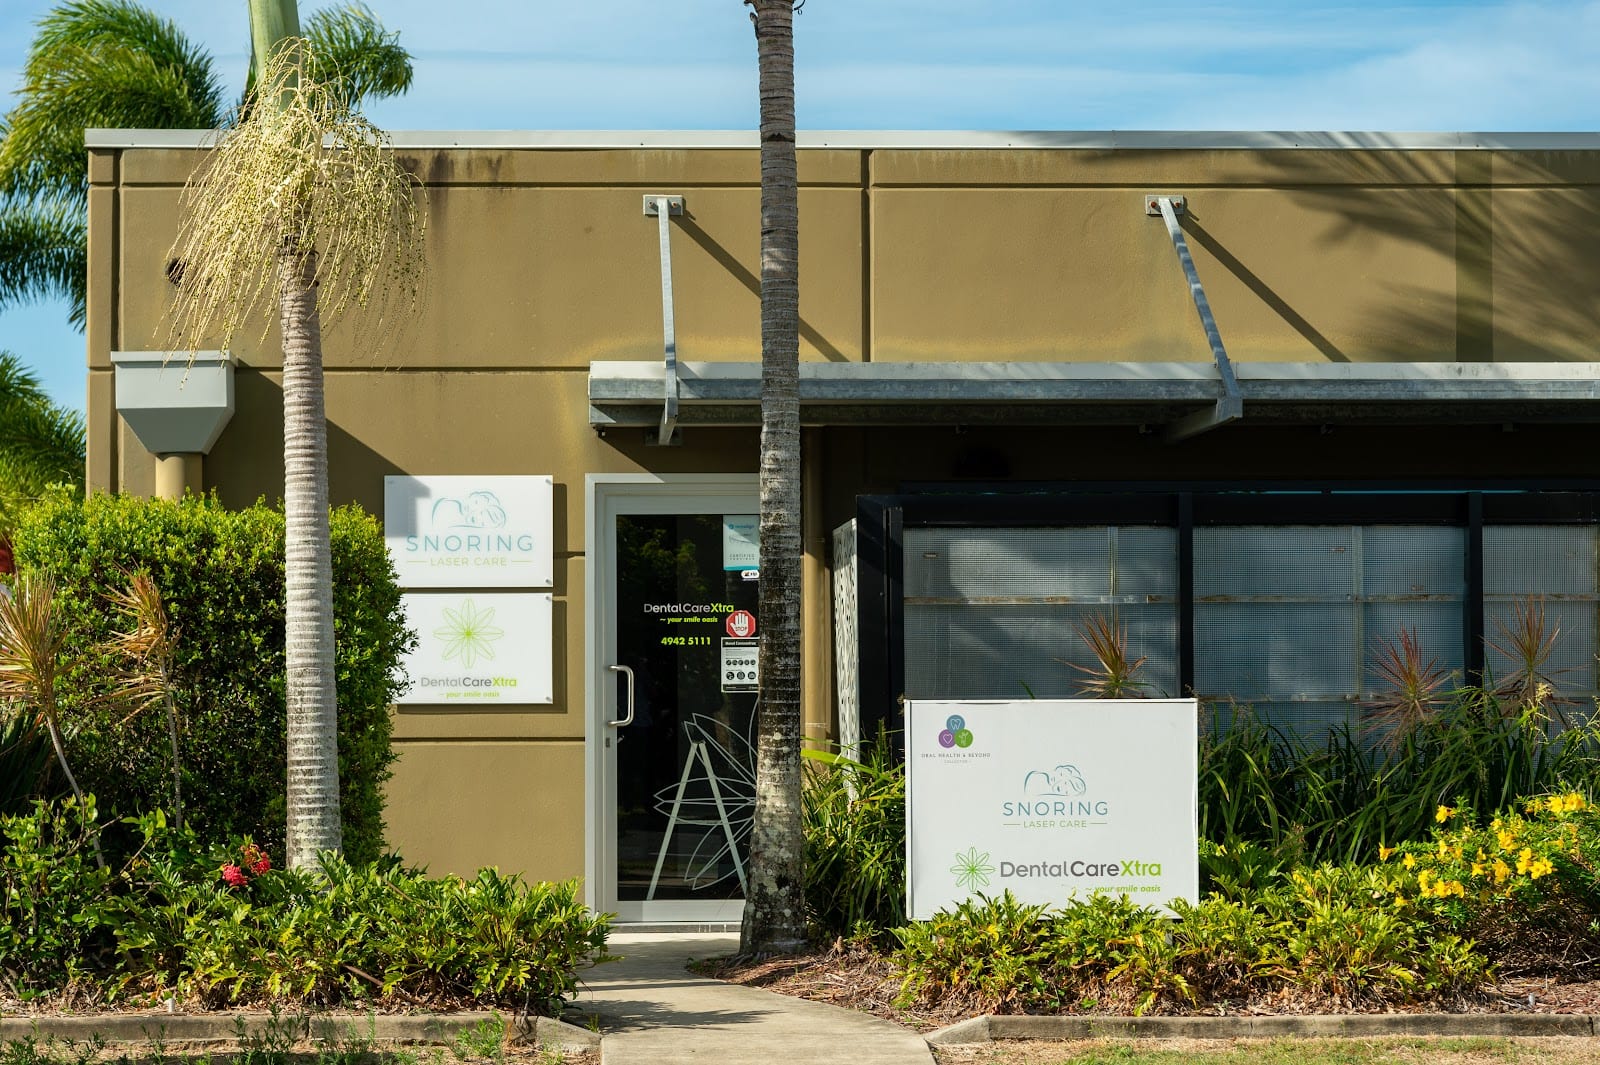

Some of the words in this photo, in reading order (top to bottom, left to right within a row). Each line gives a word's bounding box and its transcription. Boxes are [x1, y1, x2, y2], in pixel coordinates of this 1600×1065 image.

[405, 535, 534, 552] SNORING
[430, 557, 470, 567] LASER
[474, 556, 508, 567] CARE
[643, 602, 735, 614] DentalCareXtra
[667, 616, 682, 625] your
[661, 636, 686, 646] 4942
[688, 636, 711, 646] 5111
[420, 676, 518, 688] DentalCareXtra
[446, 691, 461, 699] your
[1002, 801, 1109, 817] SNORING
[1023, 820, 1056, 828] LASER
[1059, 820, 1088, 828] CARE
[1000, 860, 1162, 878] DentalCareXtra
[1095, 886, 1114, 894] your
[1116, 885, 1138, 893] smile
[1140, 885, 1161, 893] oasis
